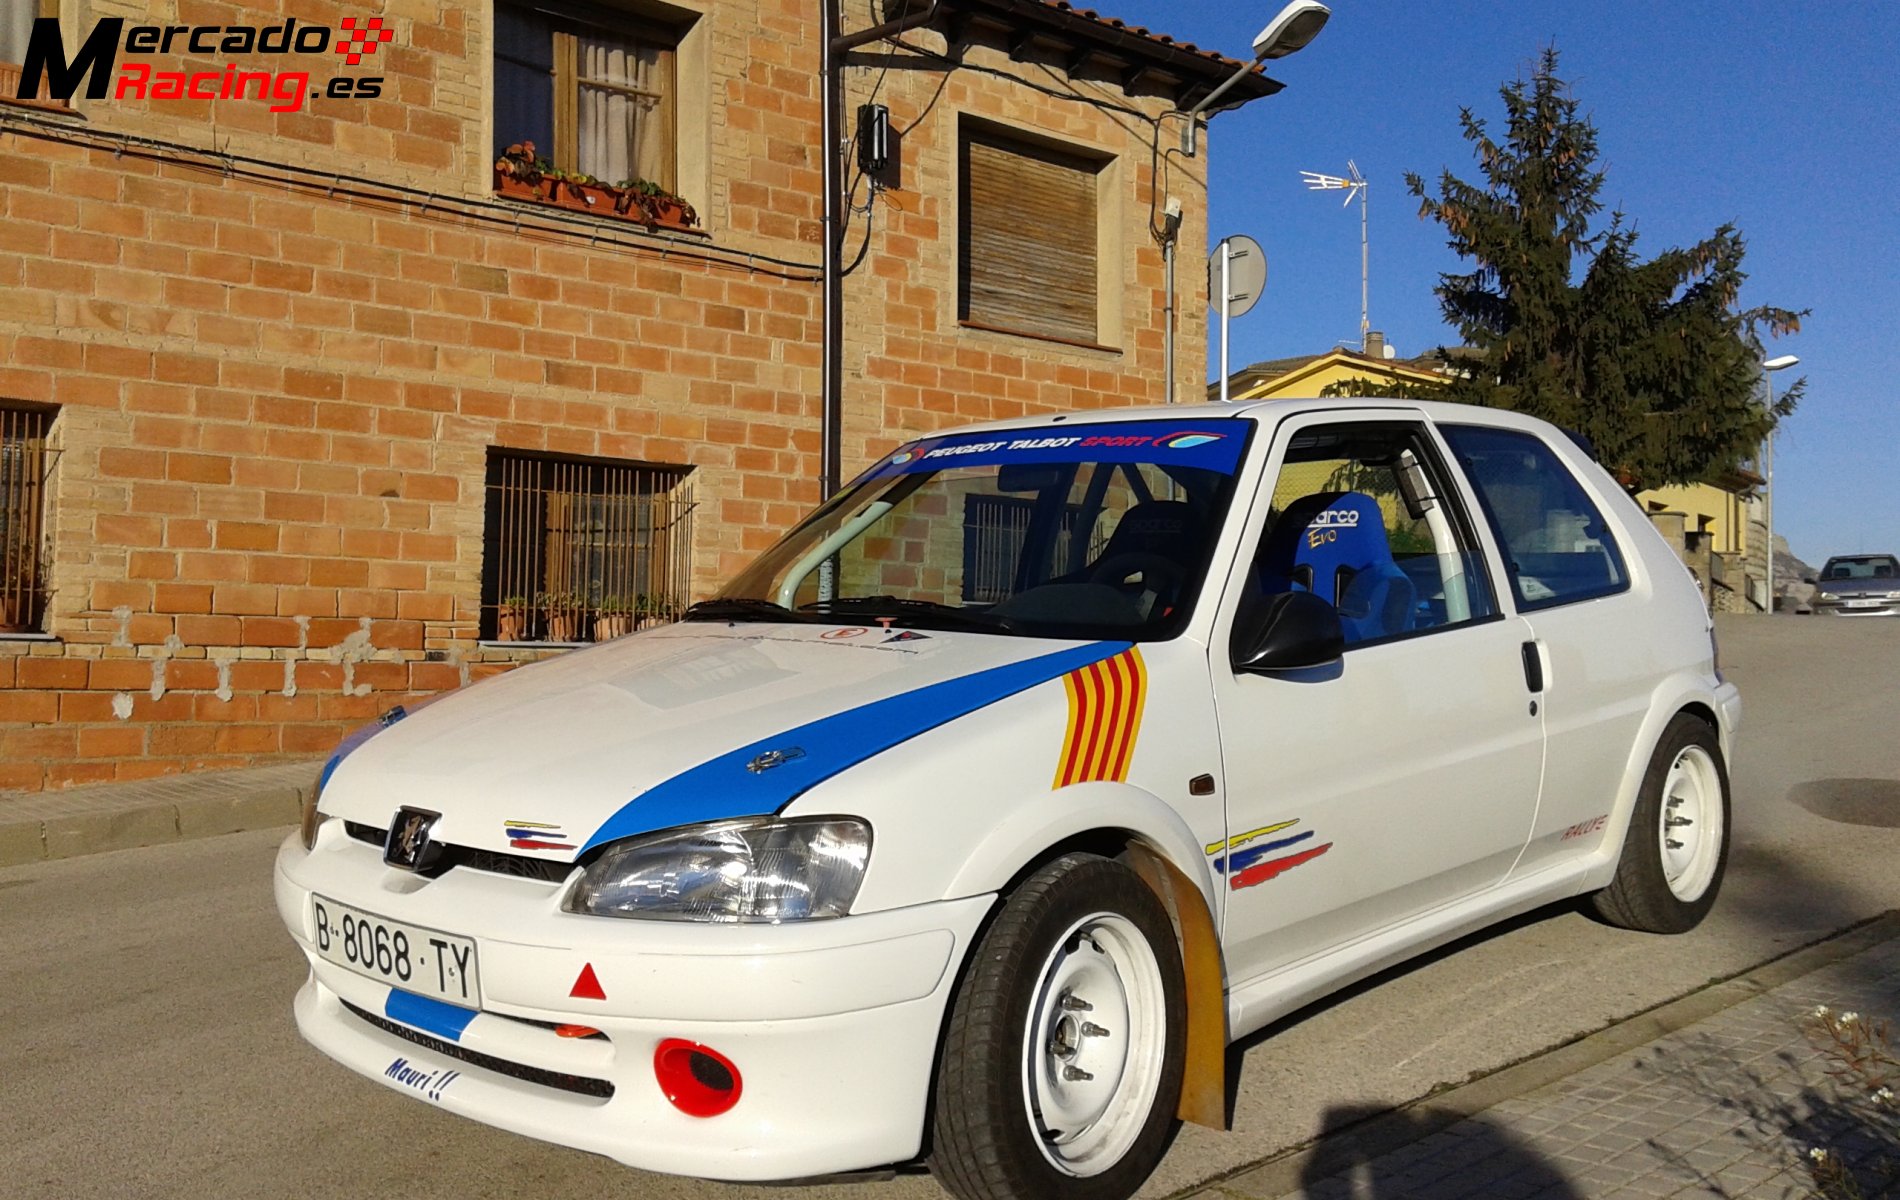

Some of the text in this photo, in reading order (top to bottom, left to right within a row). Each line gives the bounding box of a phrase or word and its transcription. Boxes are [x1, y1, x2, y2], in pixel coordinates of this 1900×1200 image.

[922, 436, 1153, 459] PEUGEOT TALBOT SPORT
[1309, 510, 1359, 526] arco
